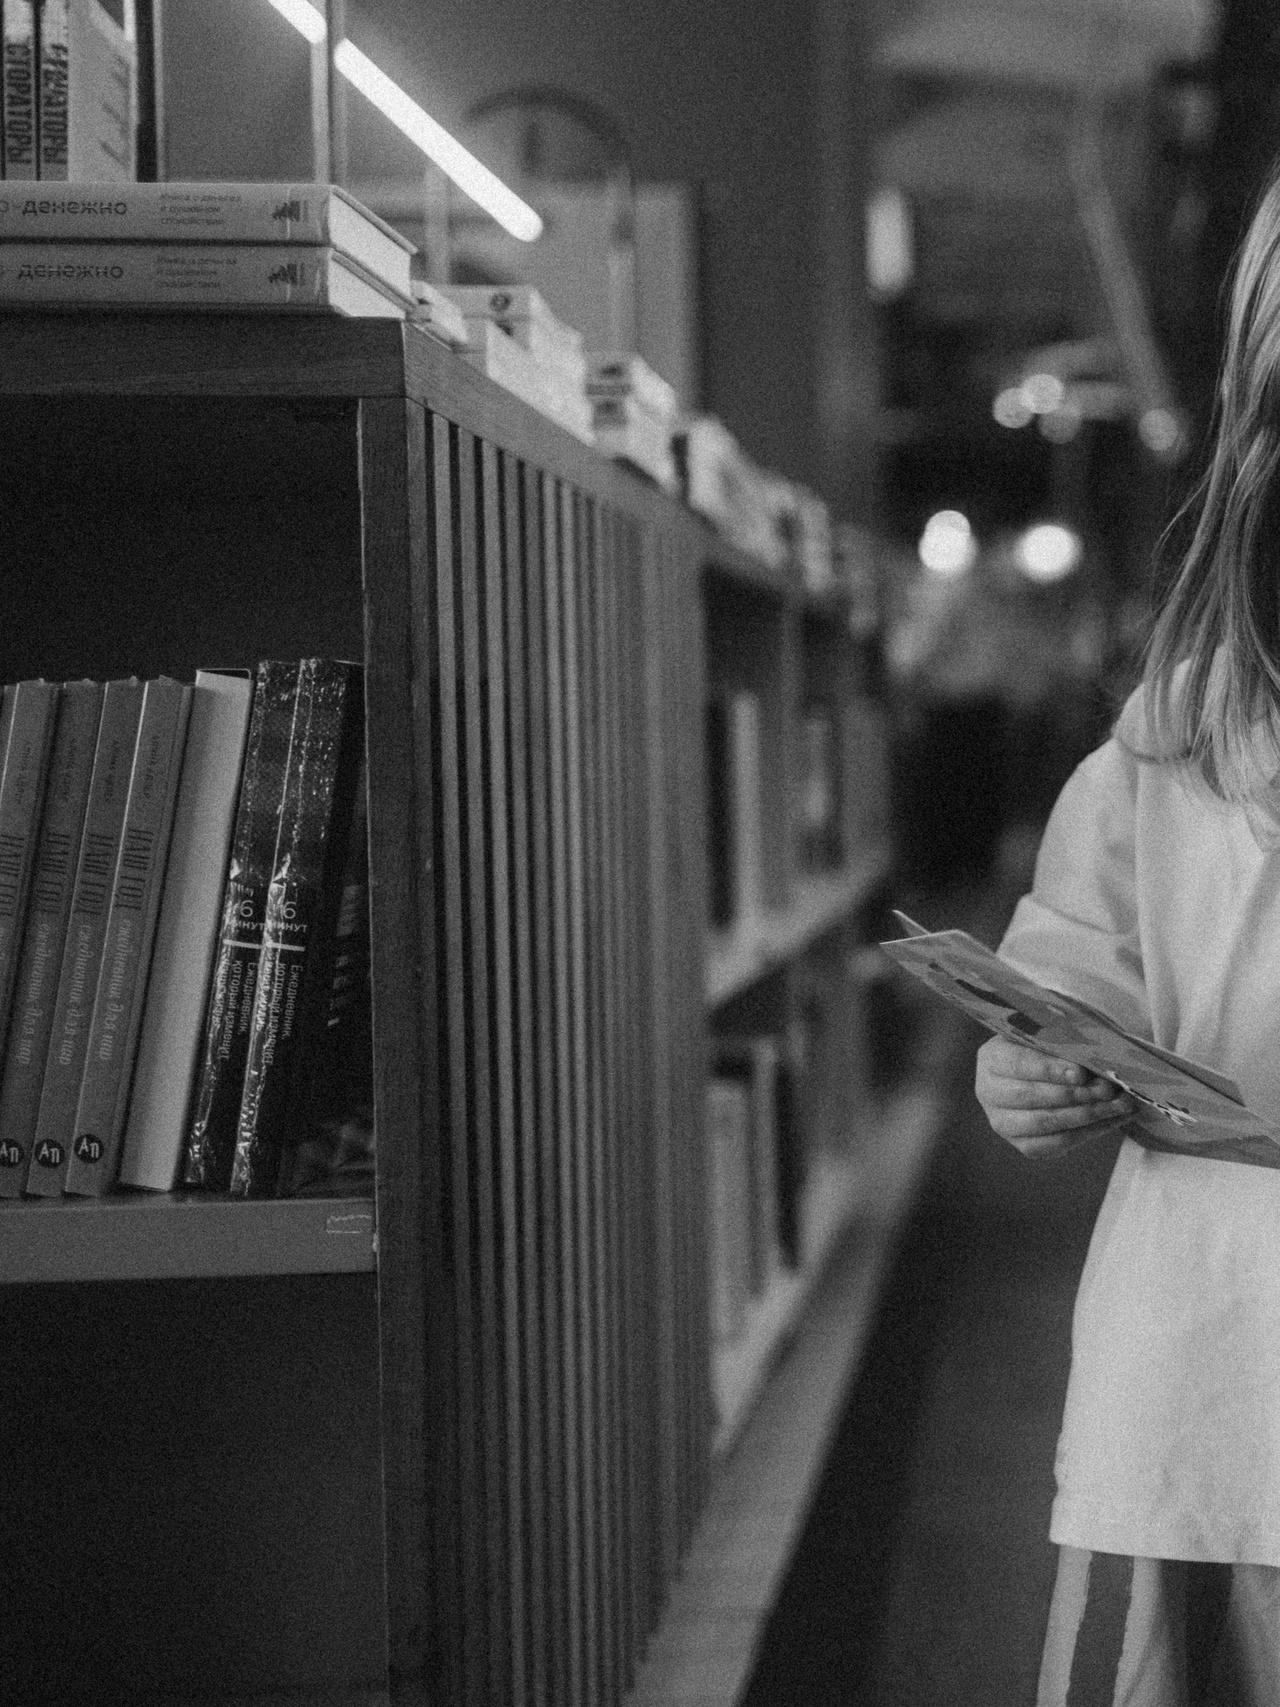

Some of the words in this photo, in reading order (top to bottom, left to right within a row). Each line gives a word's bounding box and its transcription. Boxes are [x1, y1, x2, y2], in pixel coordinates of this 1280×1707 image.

[6, 42, 34, 165] СТОРАТОРЫ
[41, 832, 71, 875] НАШ
[83, 833, 114, 875] НАШ
[122, 828, 154, 871] НАШ
[74, 881, 107, 916] ГОД
[115, 876, 146, 911] ГОД
[240, 899, 254, 918] 6
[283, 901, 297, 919] 6
[64, 1008, 84, 1036] для
[105, 1003, 124, 1032] для
[58, 1039, 74, 1065] пар
[98, 1034, 114, 1061] пар
